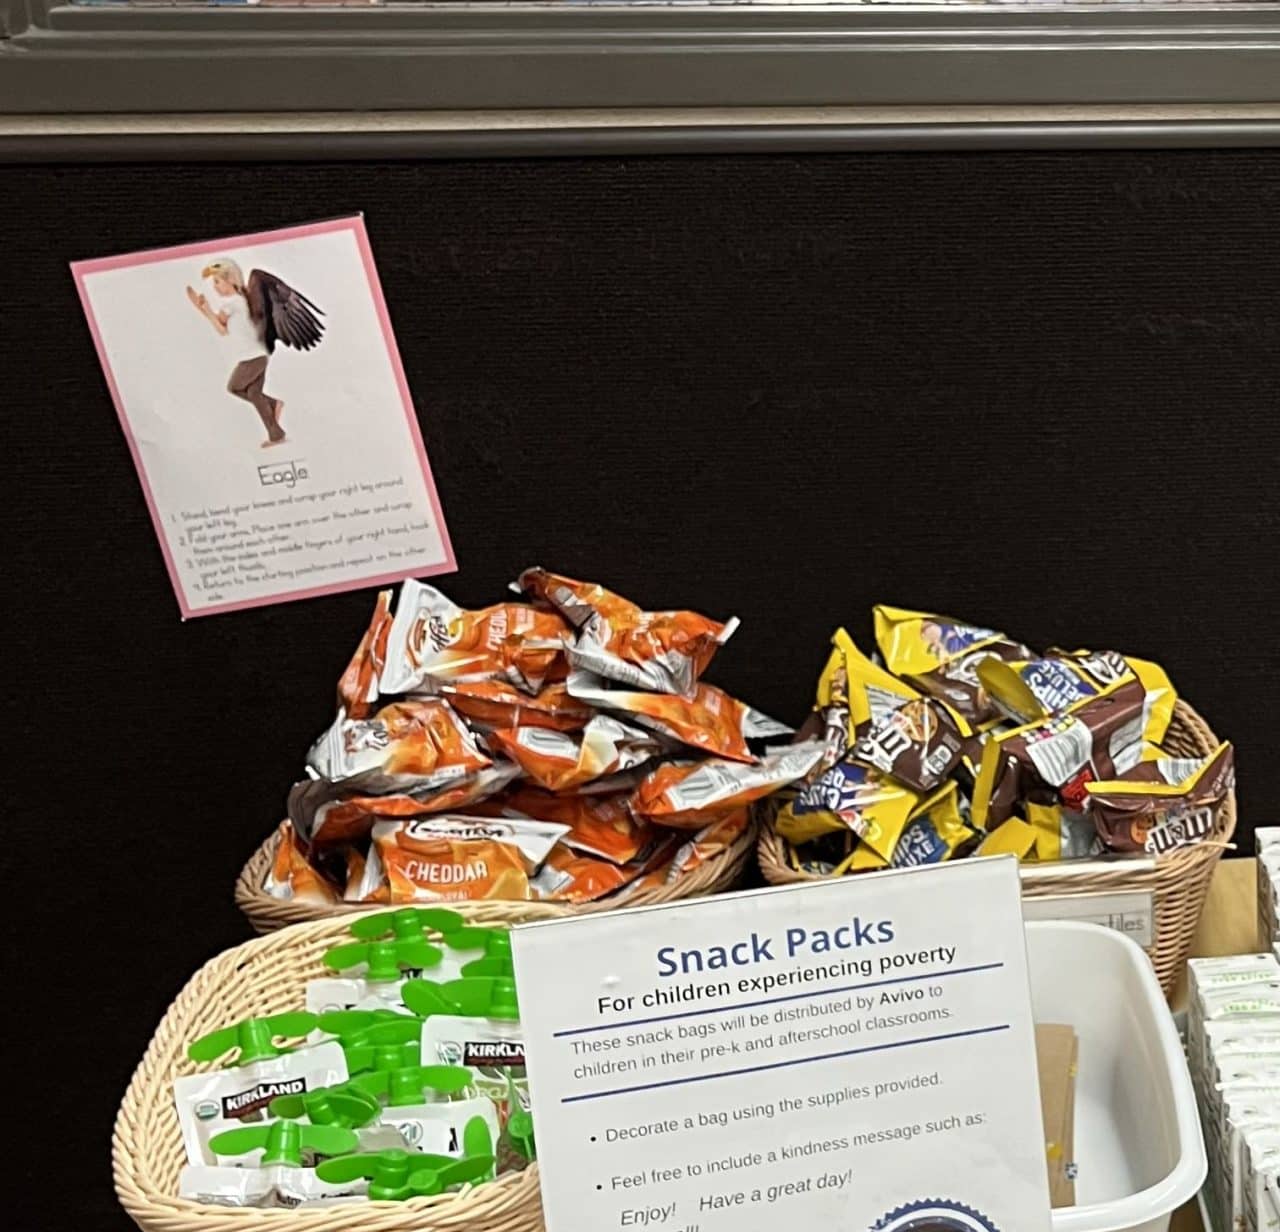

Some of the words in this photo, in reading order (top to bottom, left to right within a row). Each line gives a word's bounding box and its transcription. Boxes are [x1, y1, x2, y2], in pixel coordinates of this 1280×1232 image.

[258, 461, 308, 488] Eagle
[404, 860, 488, 884] CHEDDAR
[658, 932, 776, 977] Snack
[786, 917, 895, 958] Packs
[598, 995, 636, 1015] For
[641, 981, 731, 1008] children
[738, 960, 873, 993] experiencing
[880, 946, 957, 975] poverty
[468, 1042, 527, 1057] KIRKLA
[570, 1037, 622, 1056] These
[626, 1027, 674, 1047] snack
[678, 1023, 717, 1039] bags
[720, 1015, 746, 1031] will
[750, 1013, 769, 1027] be
[774, 998, 853, 1024] distributed
[857, 996, 875, 1012] by
[880, 989, 925, 1006] Avivo
[929, 986, 944, 998] to
[573, 1059, 638, 1080] children
[642, 1056, 656, 1069] in
[660, 1049, 695, 1065] their
[700, 1041, 741, 1062] pre-k
[745, 1034, 775, 1051] and
[779, 1020, 862, 1047] afterschool
[866, 1008, 955, 1033] classrooms.
[226, 1080, 304, 1111] KIRKLAND
[606, 1120, 679, 1143] Decorate
[684, 1117, 695, 1130] a
[698, 1112, 729, 1127] bag
[733, 1104, 775, 1121] using
[779, 1098, 803, 1112] the
[808, 1085, 871, 1108] supplies
[875, 1072, 943, 1098] provided.
[611, 1170, 647, 1190] Feel
[651, 1167, 683, 1183] free
[687, 1165, 703, 1177] to
[707, 1152, 763, 1173] include
[767, 1151, 778, 1163] a
[781, 1138, 849, 1160] kindness
[853, 1125, 921, 1146] message
[926, 1114, 962, 1133] such
[965, 1112, 987, 1127] as:
[620, 1201, 677, 1226] Enjoy!
[699, 1192, 745, 1212] Have
[750, 1188, 762, 1202] a
[767, 1178, 812, 1203] great
[816, 1168, 853, 1189] day!
